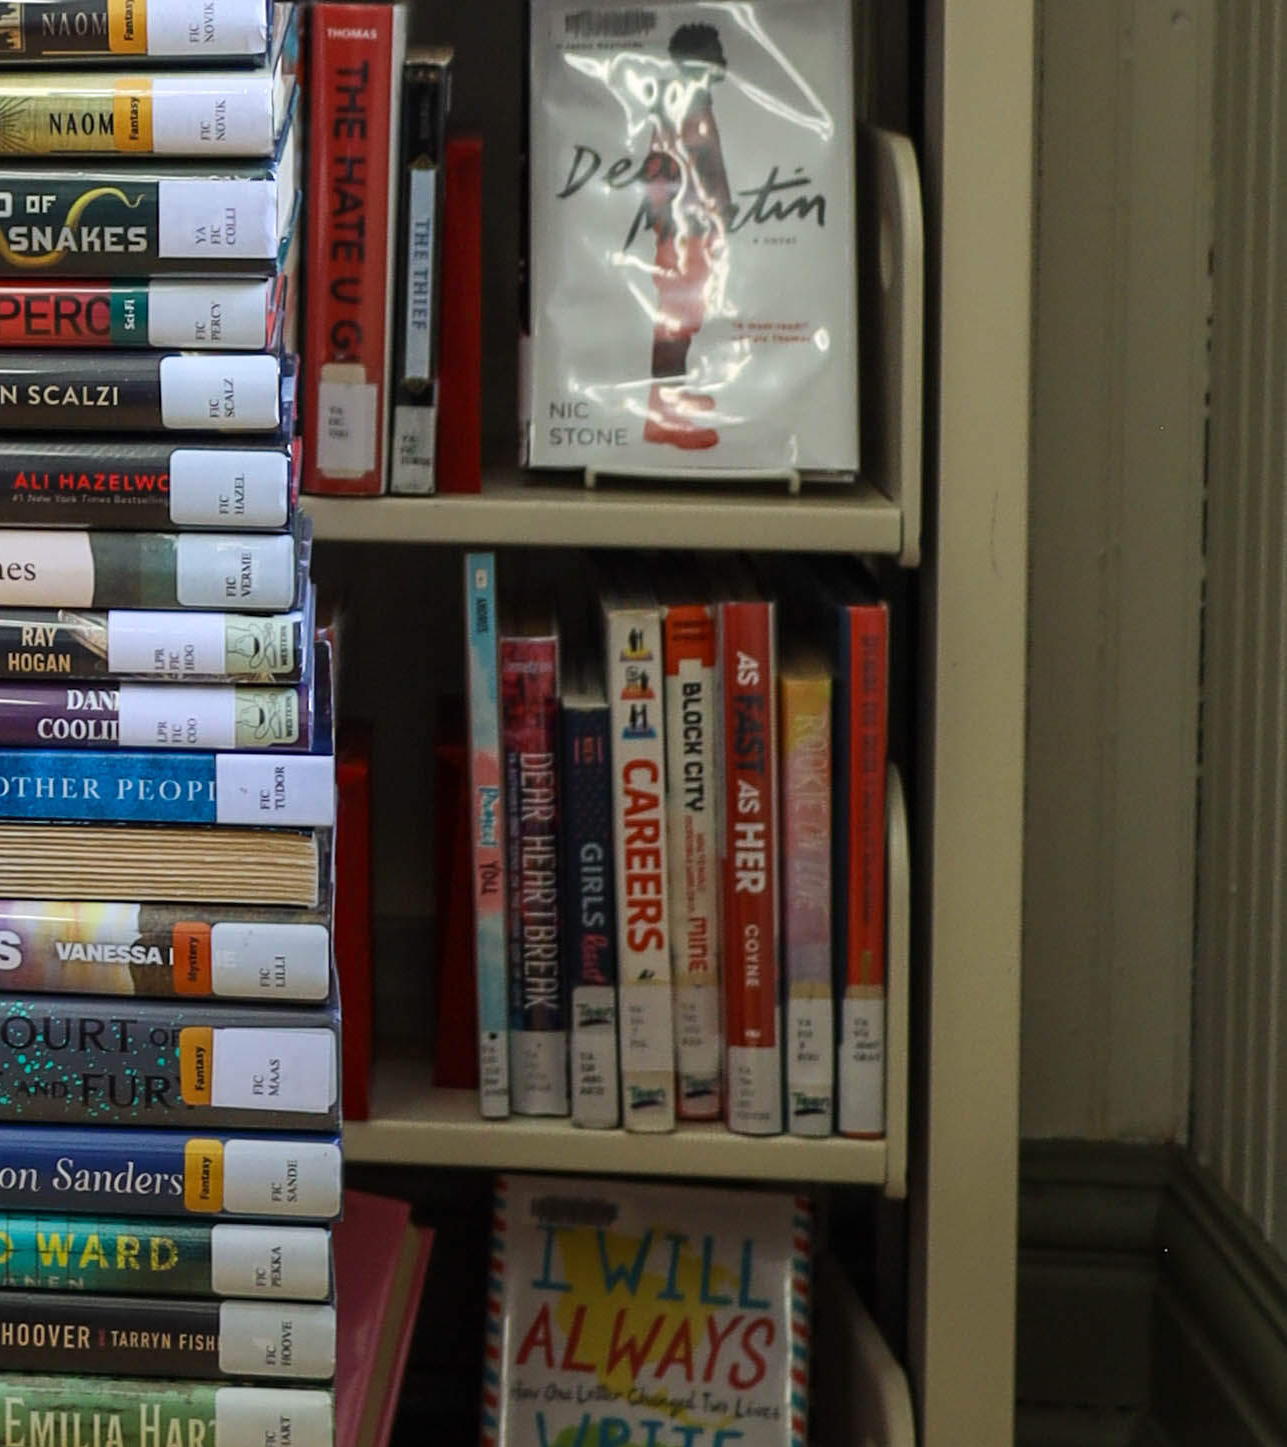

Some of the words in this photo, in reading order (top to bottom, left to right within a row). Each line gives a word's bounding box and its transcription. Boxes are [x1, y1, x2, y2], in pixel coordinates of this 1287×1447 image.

[327, 28, 377, 40] THOMAS
[130, 97, 139, 141] Fantasy
[332, 60, 368, 140] THE
[26, 194, 55, 213] OF
[330, 156, 368, 262] HATE
[9, 225, 147, 252] SNAKES
[412, 219, 429, 259] THE
[27, 385, 119, 406] SCALZI
[548, 402, 588, 422] NIC
[548, 426, 627, 446] STONE
[14, 473, 49, 490] ALI
[22, 627, 57, 646] RAY
[8, 653, 71, 672] HOGAN
[681, 682, 702, 758] BLOCK
[684, 762, 704, 813] CITY
[622, 760, 665, 953] CAREERS
[735, 824, 766, 894] HER
[580, 844, 604, 929] GIRLS
[56, 942, 163, 965] VANESSA
[745, 924, 759, 988] COYNE
[37, 1232, 178, 1271] WARD
[532, 1223, 577, 1291] I
[597, 1227, 770, 1310] WILL
[2, 1323, 91, 1349] HOOVER
[517, 1305, 777, 1391] ALWAYS
